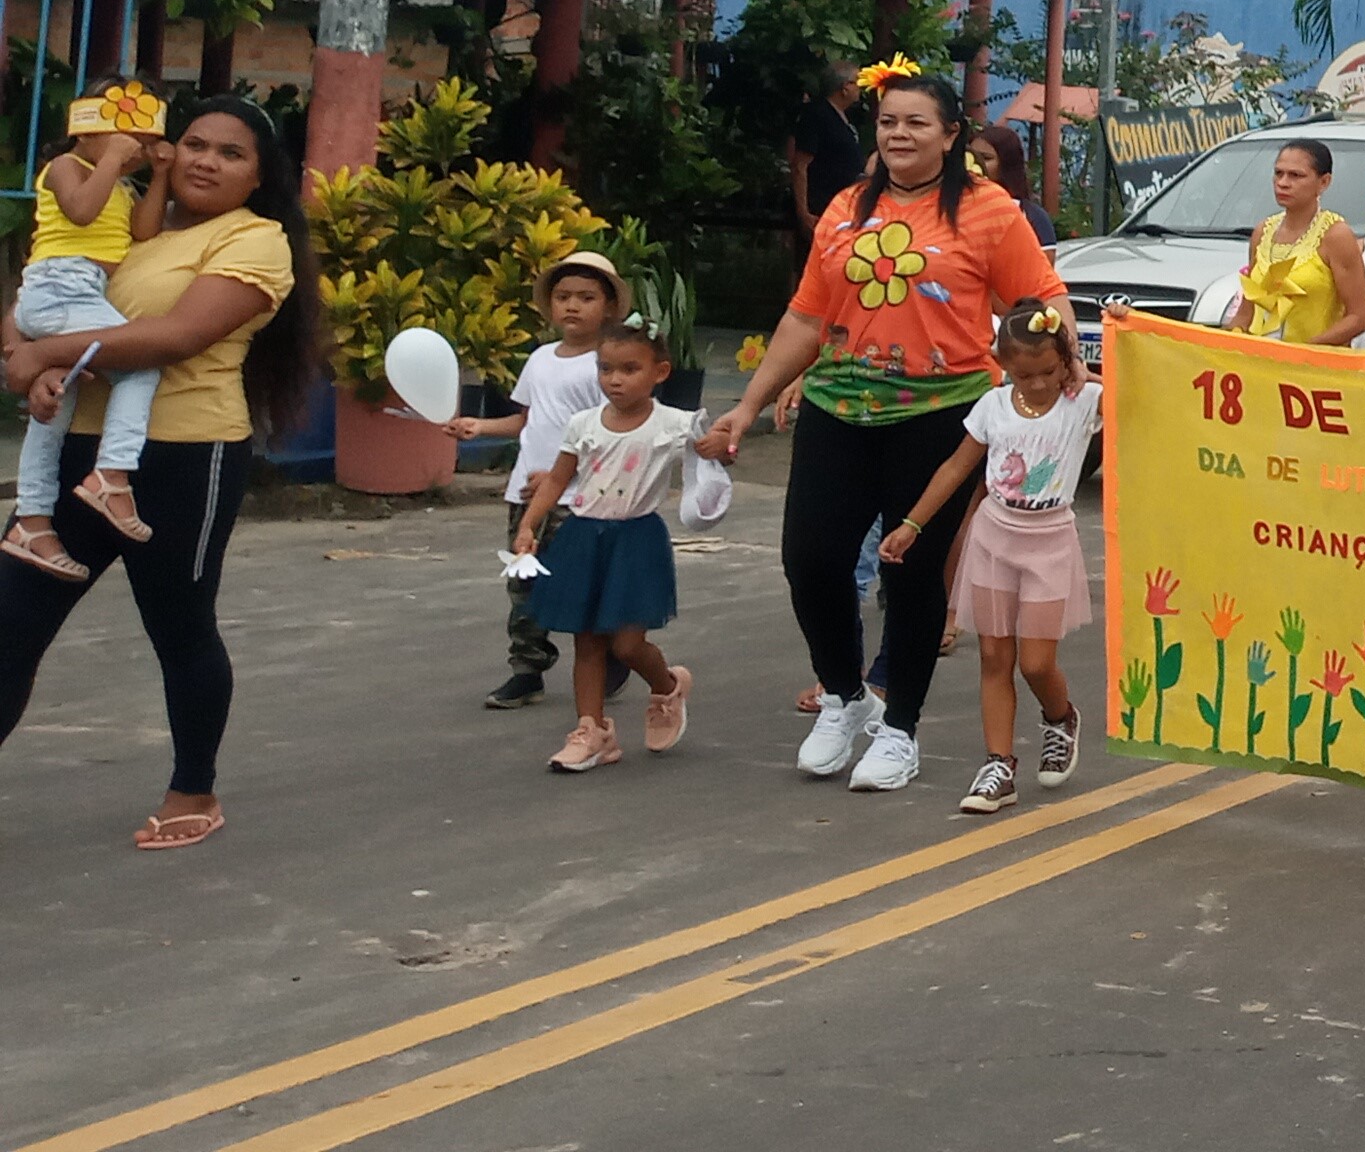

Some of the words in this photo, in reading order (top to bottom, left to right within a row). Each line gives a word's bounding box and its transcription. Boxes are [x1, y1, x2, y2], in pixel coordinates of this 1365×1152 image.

[1107, 112, 1195, 165] Comidas
[1191, 370, 1244, 426] 18
[1278, 382, 1350, 436] DE
[1197, 447, 1246, 479] DIA
[1266, 455, 1300, 483] DE
